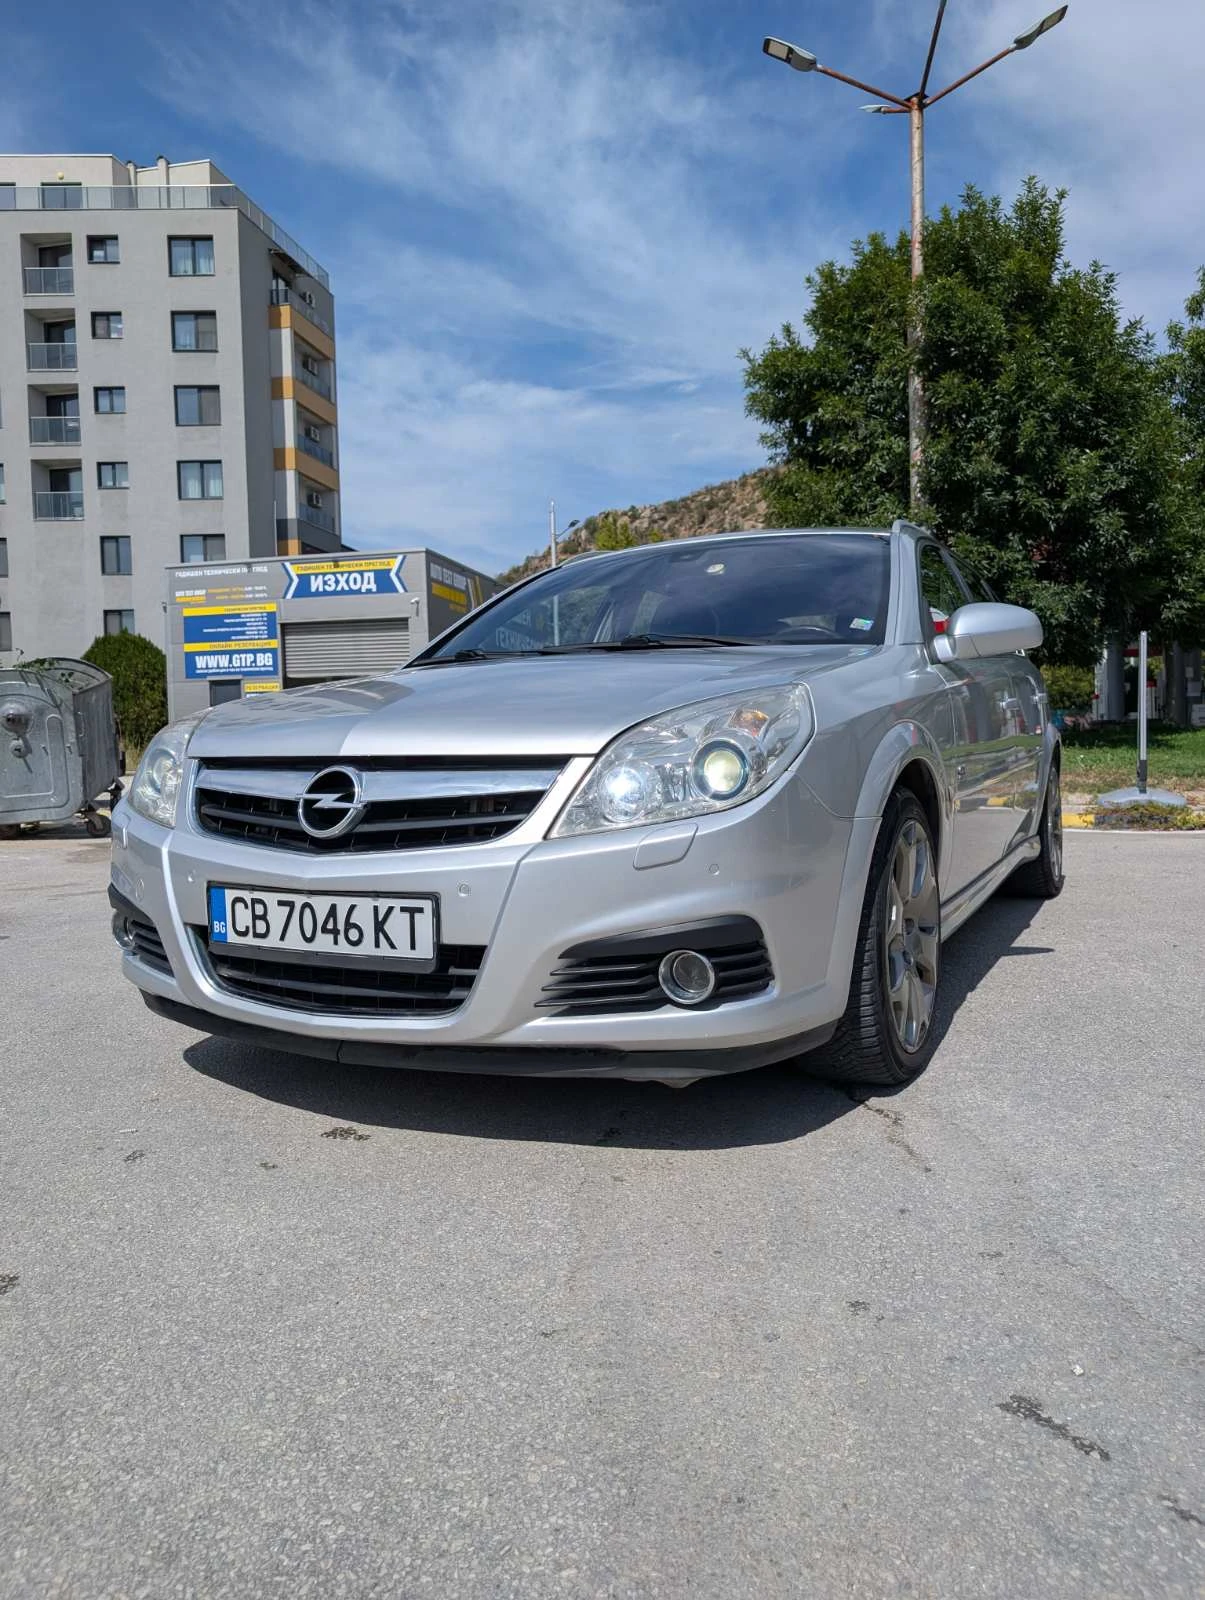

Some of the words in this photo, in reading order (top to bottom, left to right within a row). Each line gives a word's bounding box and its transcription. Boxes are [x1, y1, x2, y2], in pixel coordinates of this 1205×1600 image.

[310, 571, 377, 593] ИЗХОД
[195, 652, 273, 669] WWW.GTP.BG
[213, 920, 226, 933] BG
